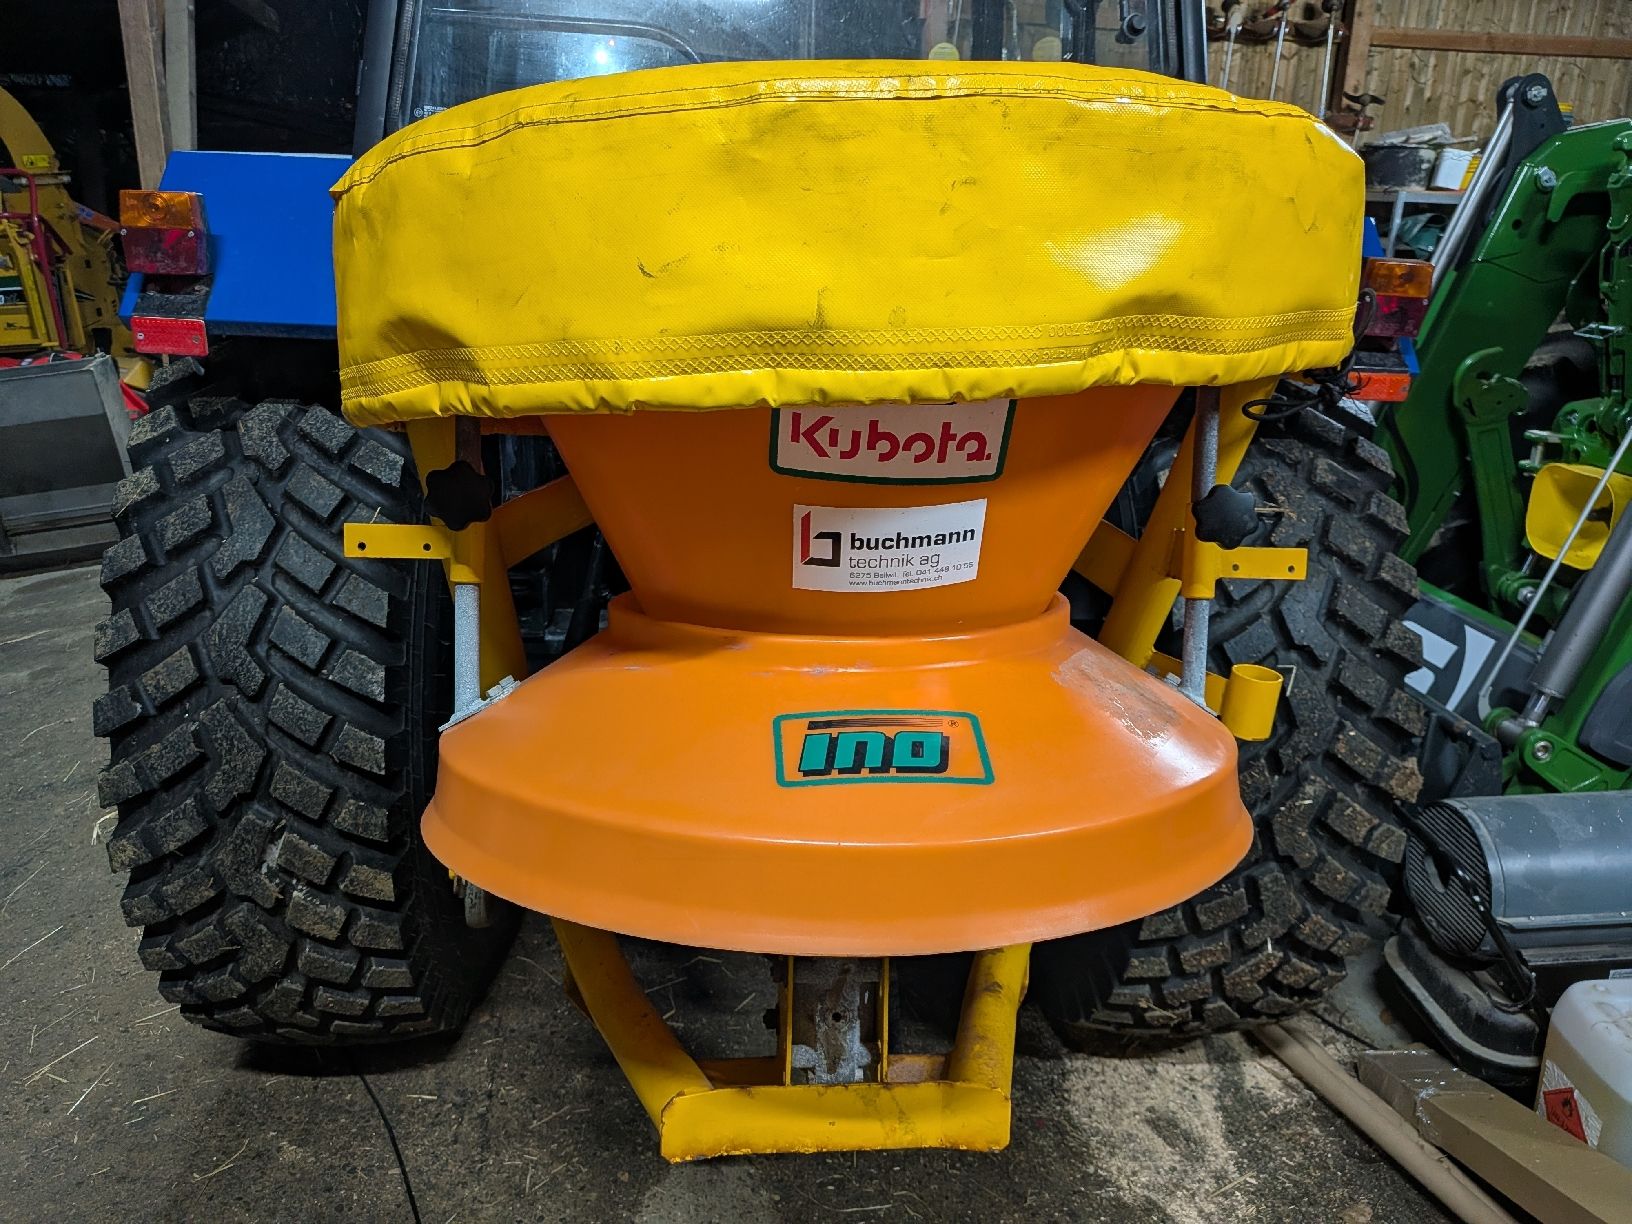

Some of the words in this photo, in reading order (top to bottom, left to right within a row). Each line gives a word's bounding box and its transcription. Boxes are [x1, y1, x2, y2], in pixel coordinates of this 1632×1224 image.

[850, 528, 976, 551] buchmann
[849, 554, 915, 569] technik
[919, 553, 941, 567] ag
[849, 571, 872, 579] 6275
[915, 568, 931, 576] 041
[952, 563, 962, 571] 10
[798, 719, 950, 776] ino
